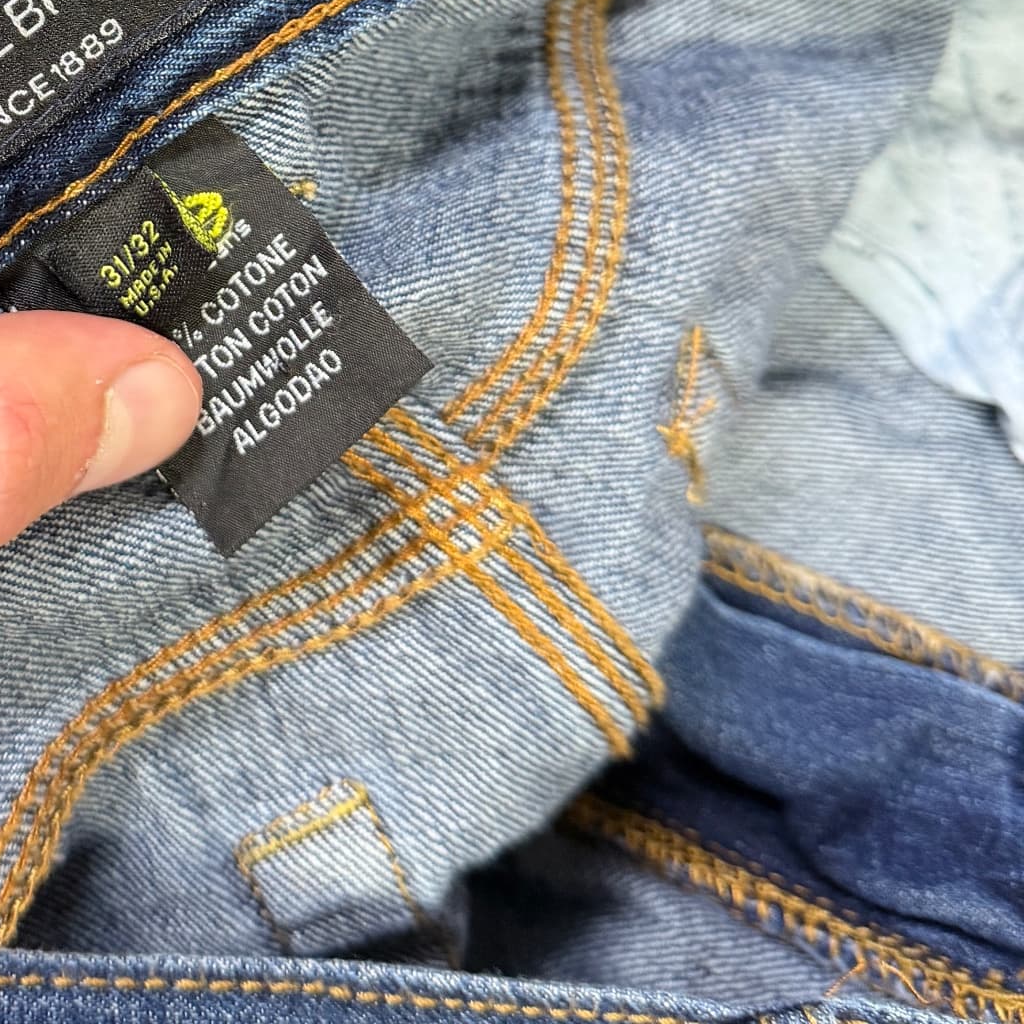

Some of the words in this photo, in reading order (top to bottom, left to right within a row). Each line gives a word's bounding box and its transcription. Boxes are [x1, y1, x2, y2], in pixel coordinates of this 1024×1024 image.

[50, 17, 126, 82] 1889
[99, 220, 160, 289] 31/32
[119, 259, 159, 309] MADE
[157, 241, 173, 265] IN
[201, 232, 297, 325] COTONE
[193, 327, 253, 379] TON
[248, 254, 329, 336] COTON
[196, 300, 334, 436] BAUMWOLLE
[232, 348, 342, 456] ALGODAO
